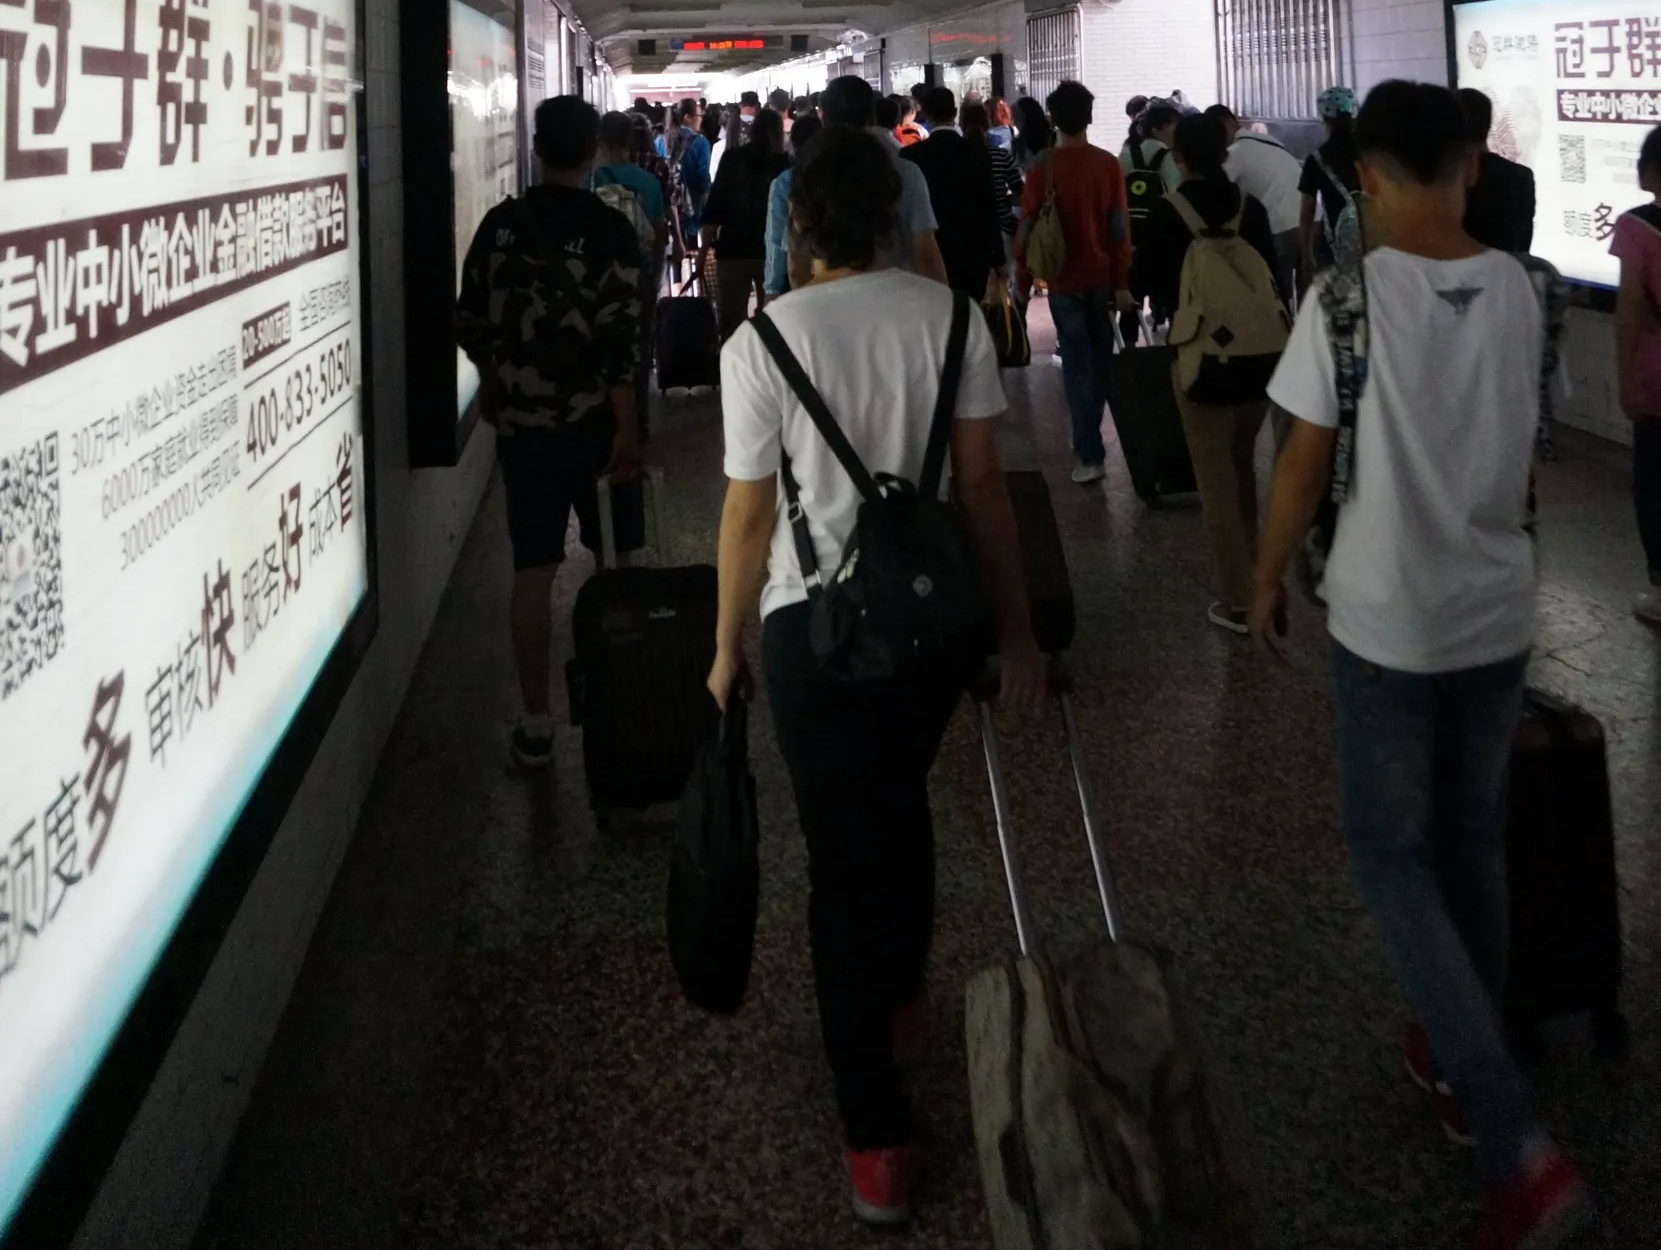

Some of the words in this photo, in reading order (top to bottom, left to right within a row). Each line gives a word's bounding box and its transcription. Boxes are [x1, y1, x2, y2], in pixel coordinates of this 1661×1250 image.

[1560, 91, 1661, 120] 专业中小微企
[0, 181, 347, 368] 专业中小微企业金融借款服务平台
[246, 337, 351, 463] 400-833-5050
[145, 557, 235, 768] 审核快
[242, 480, 302, 652] 服务好
[308, 431, 353, 566] 成本省
